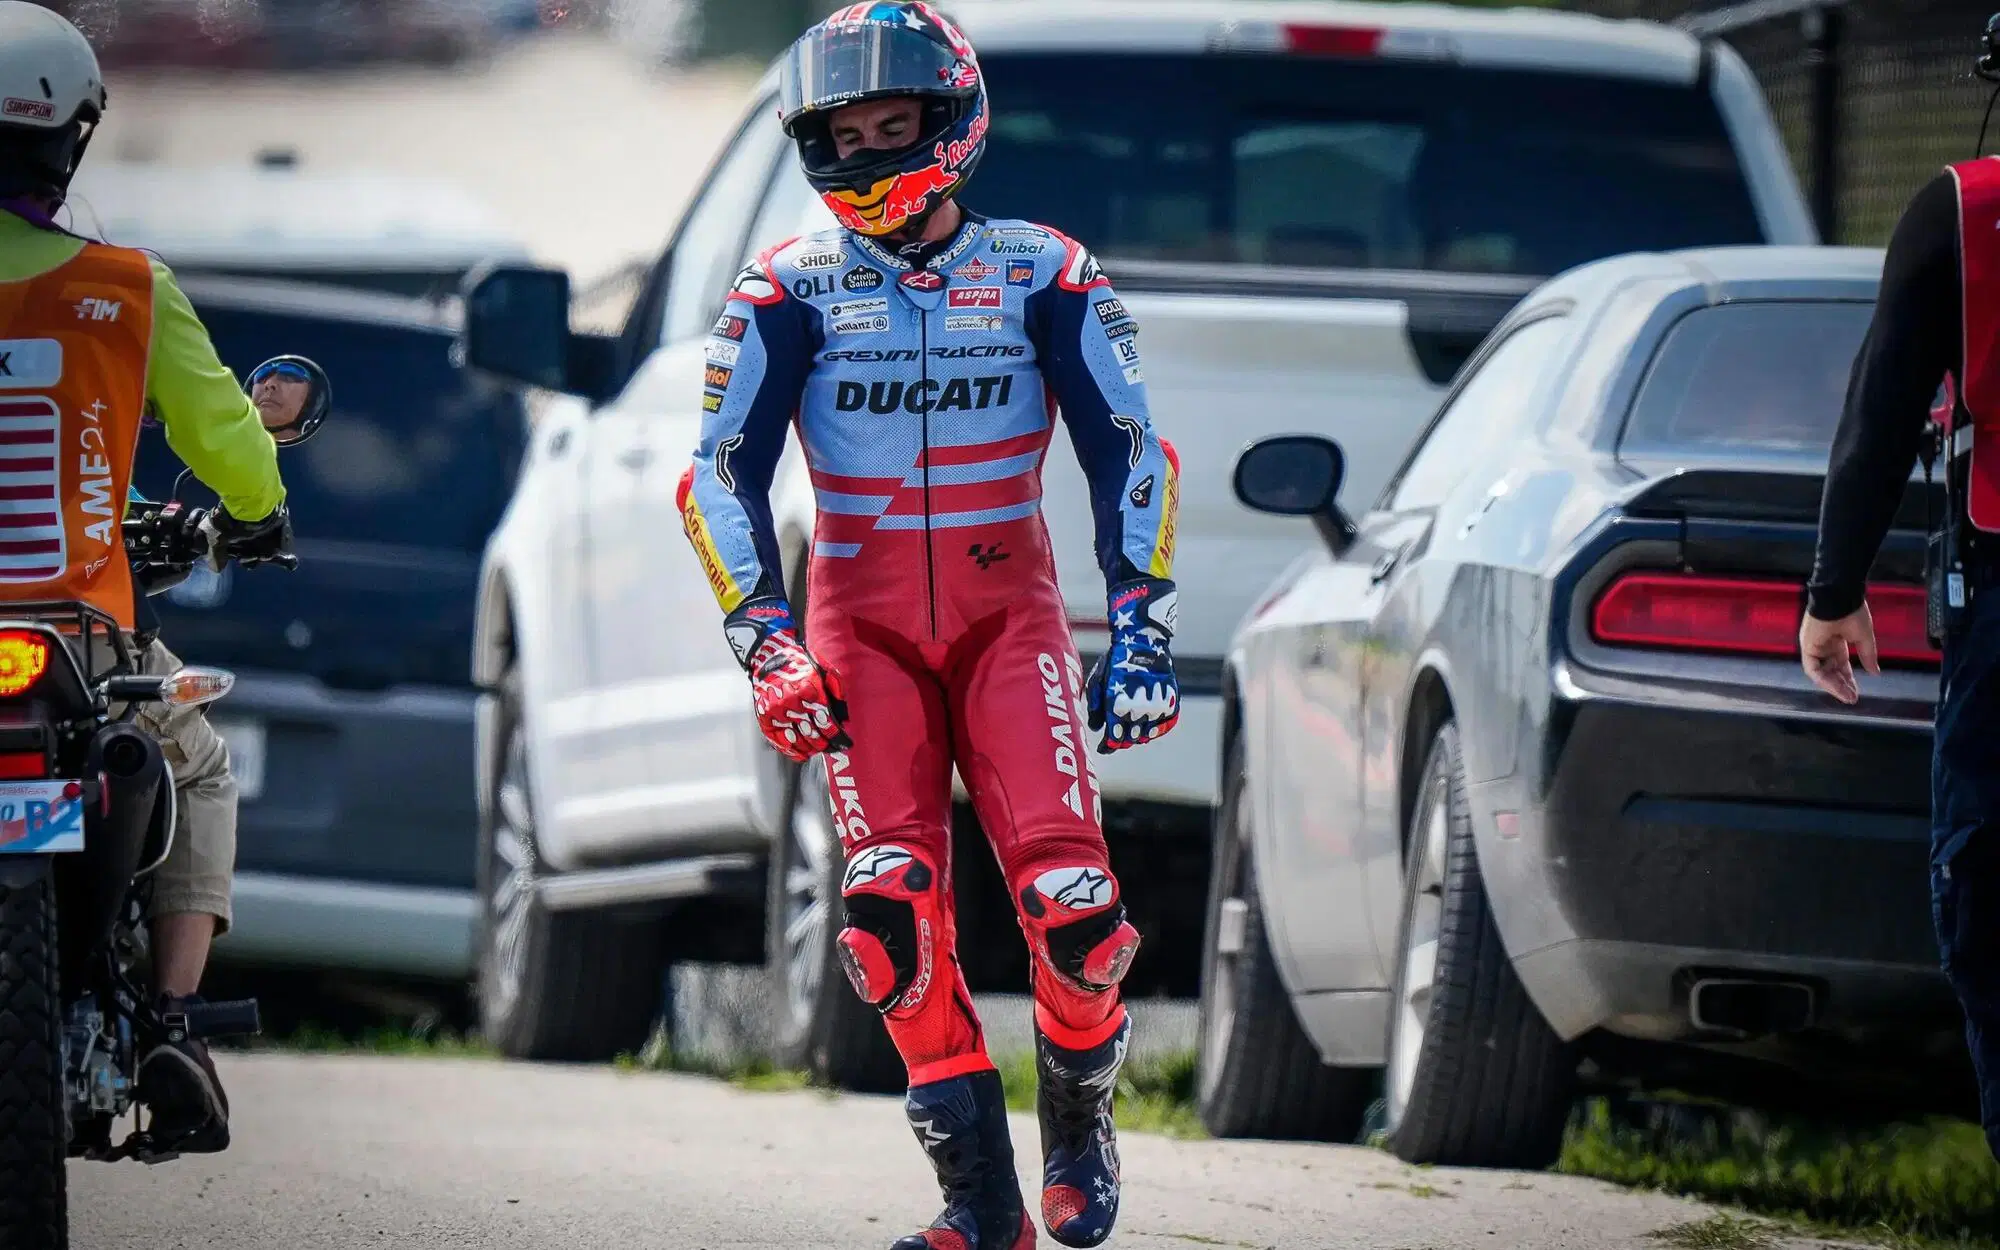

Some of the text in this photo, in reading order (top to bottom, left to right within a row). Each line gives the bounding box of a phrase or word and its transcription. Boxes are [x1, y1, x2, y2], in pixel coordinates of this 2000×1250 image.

[813, 90, 864, 105] VERTICAL
[6, 101, 53, 117] SIMPSON
[926, 222, 979, 270] alpinestars
[990, 240, 1045, 254] Unibat
[800, 253, 840, 268] SHOEI
[848, 272, 877, 282] Estrella
[954, 266, 983, 275] FEDERAL
[849, 281, 877, 289] Galicia
[956, 288, 998, 300] ASPIRA
[74, 298, 121, 322] FIM
[1097, 301, 1123, 316] BOLD
[836, 321, 872, 332] Allianz
[823, 345, 1025, 362] GRESINI RACING
[836, 375, 1012, 414] DUCATI
[685, 504, 728, 597] Antangin
[1038, 652, 1079, 778] DAIKO
[829, 751, 872, 842] AIKO
